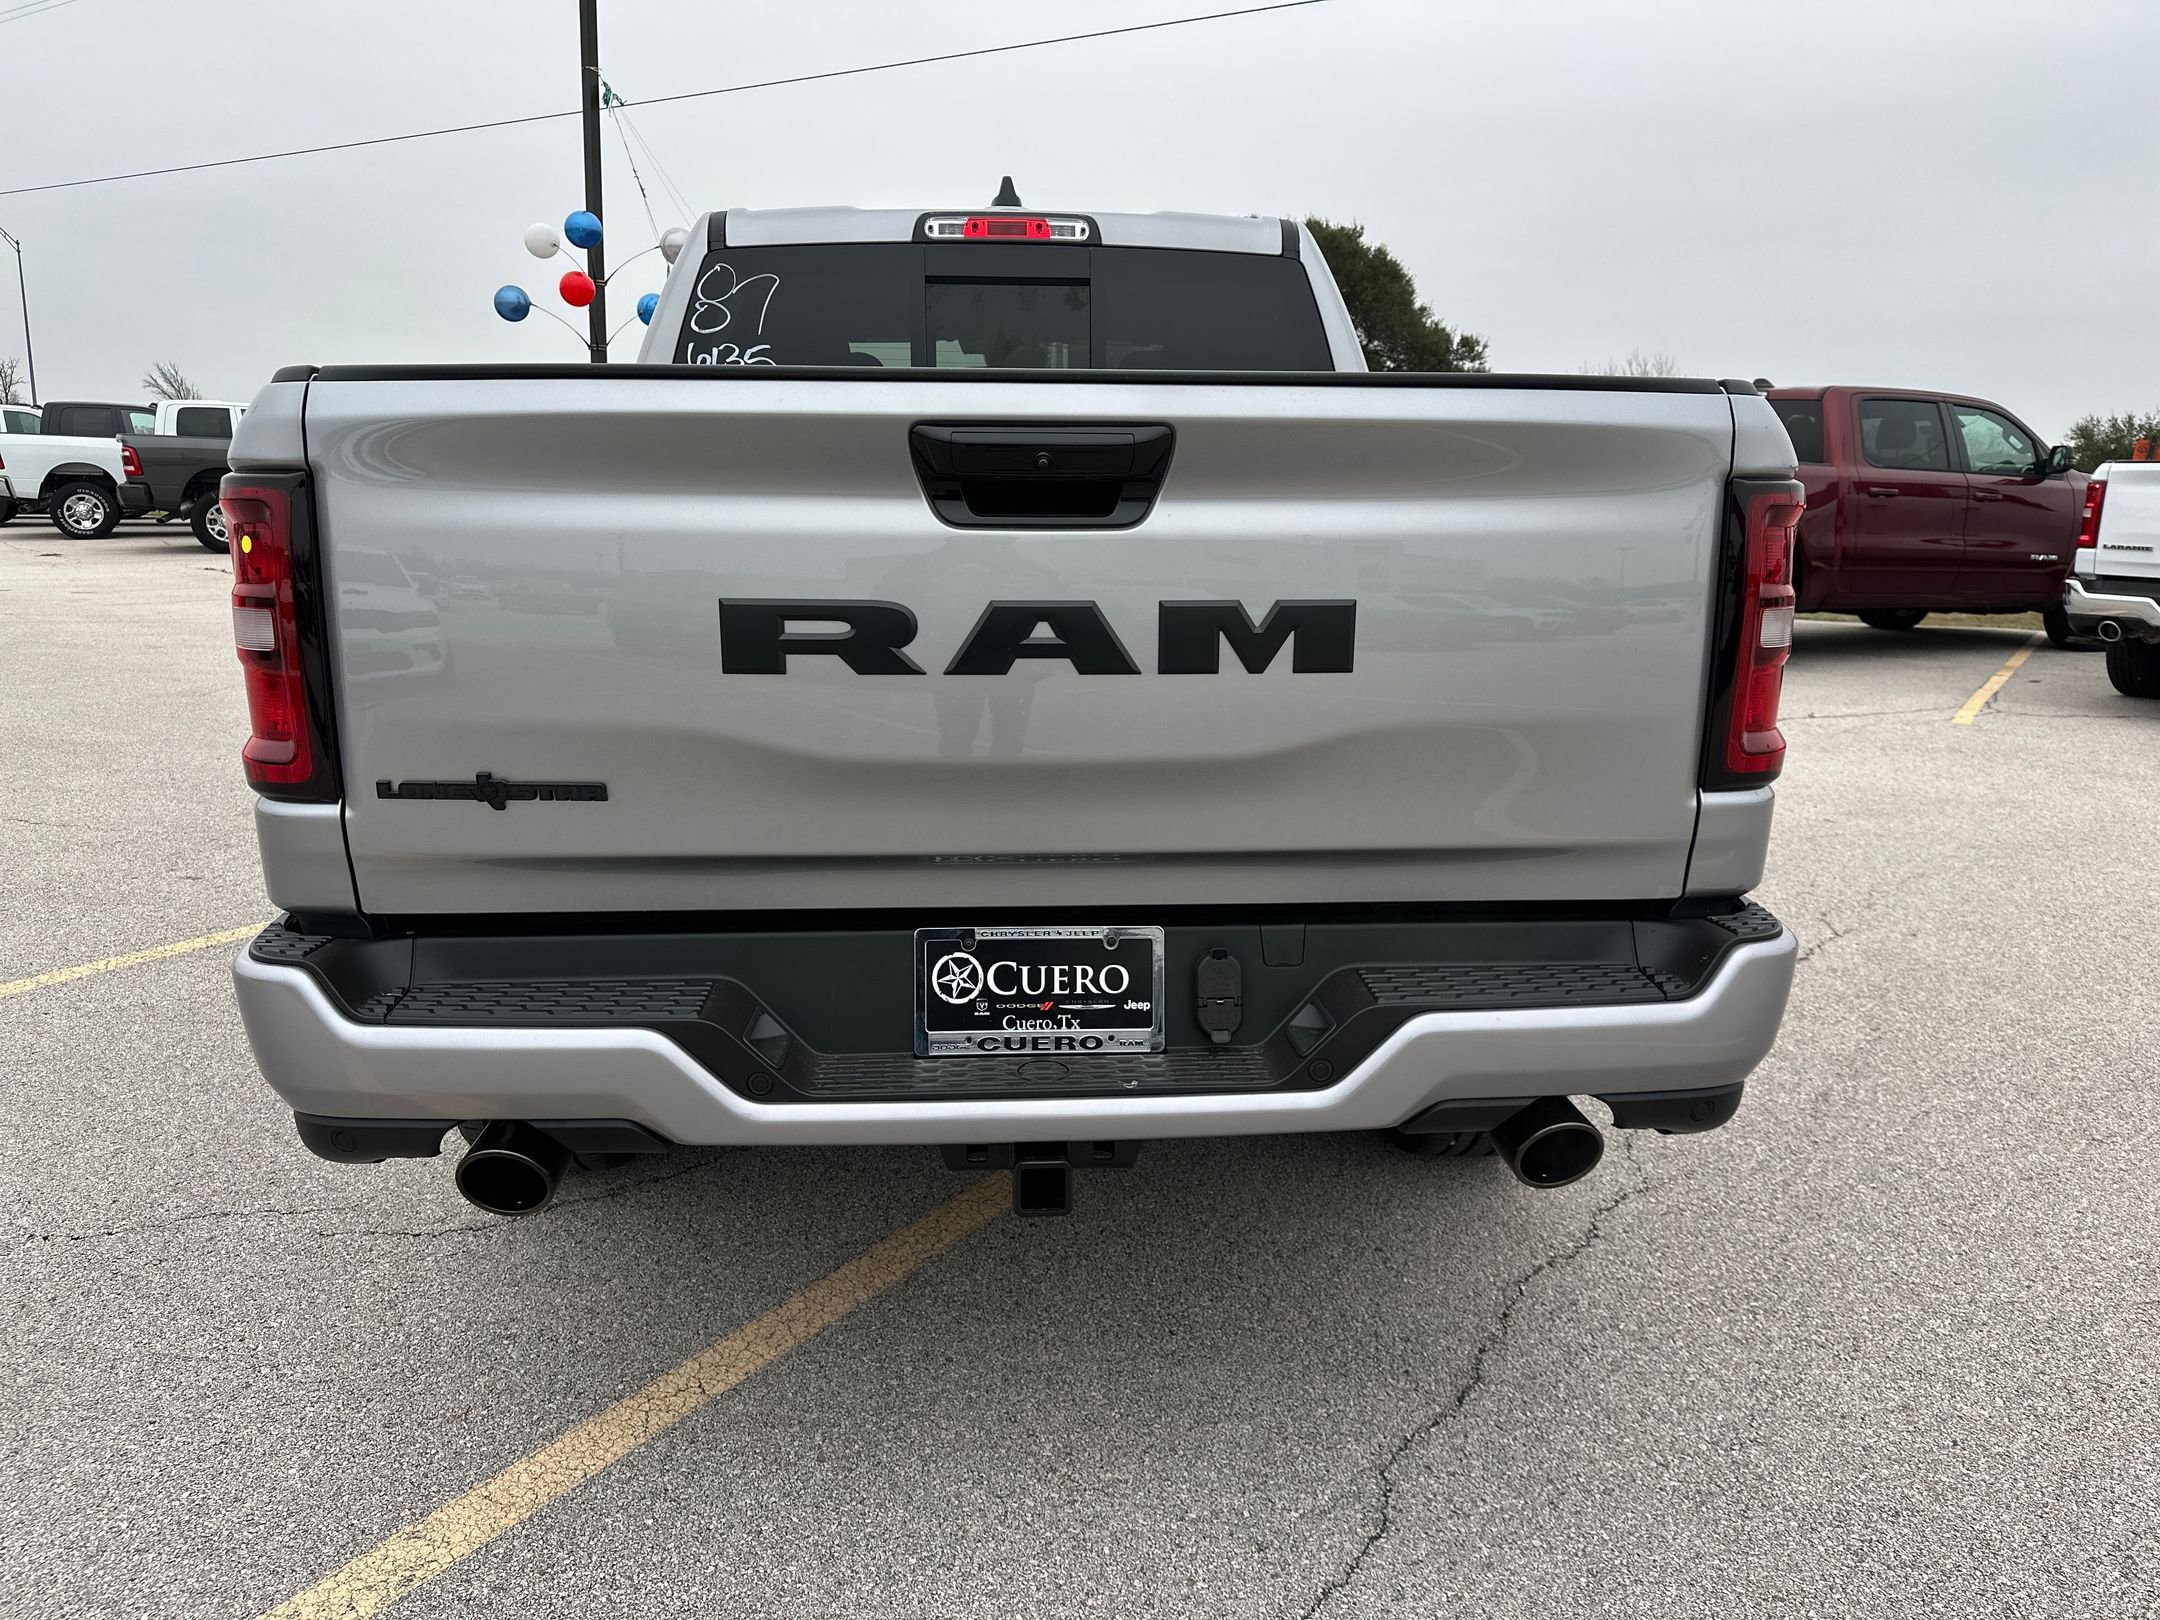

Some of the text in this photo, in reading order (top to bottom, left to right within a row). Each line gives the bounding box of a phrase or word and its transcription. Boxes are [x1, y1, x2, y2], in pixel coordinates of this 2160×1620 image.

[690, 263, 780, 336] 87
[2102, 543, 2154, 552] LARAMIE
[718, 597, 1357, 675] RAM
[376, 779, 608, 801] LONE STAR
[1123, 1000, 1151, 1011] Jeep
[977, 1035, 1104, 1051] CUERO
[1119, 1039, 1144, 1047] RAM
